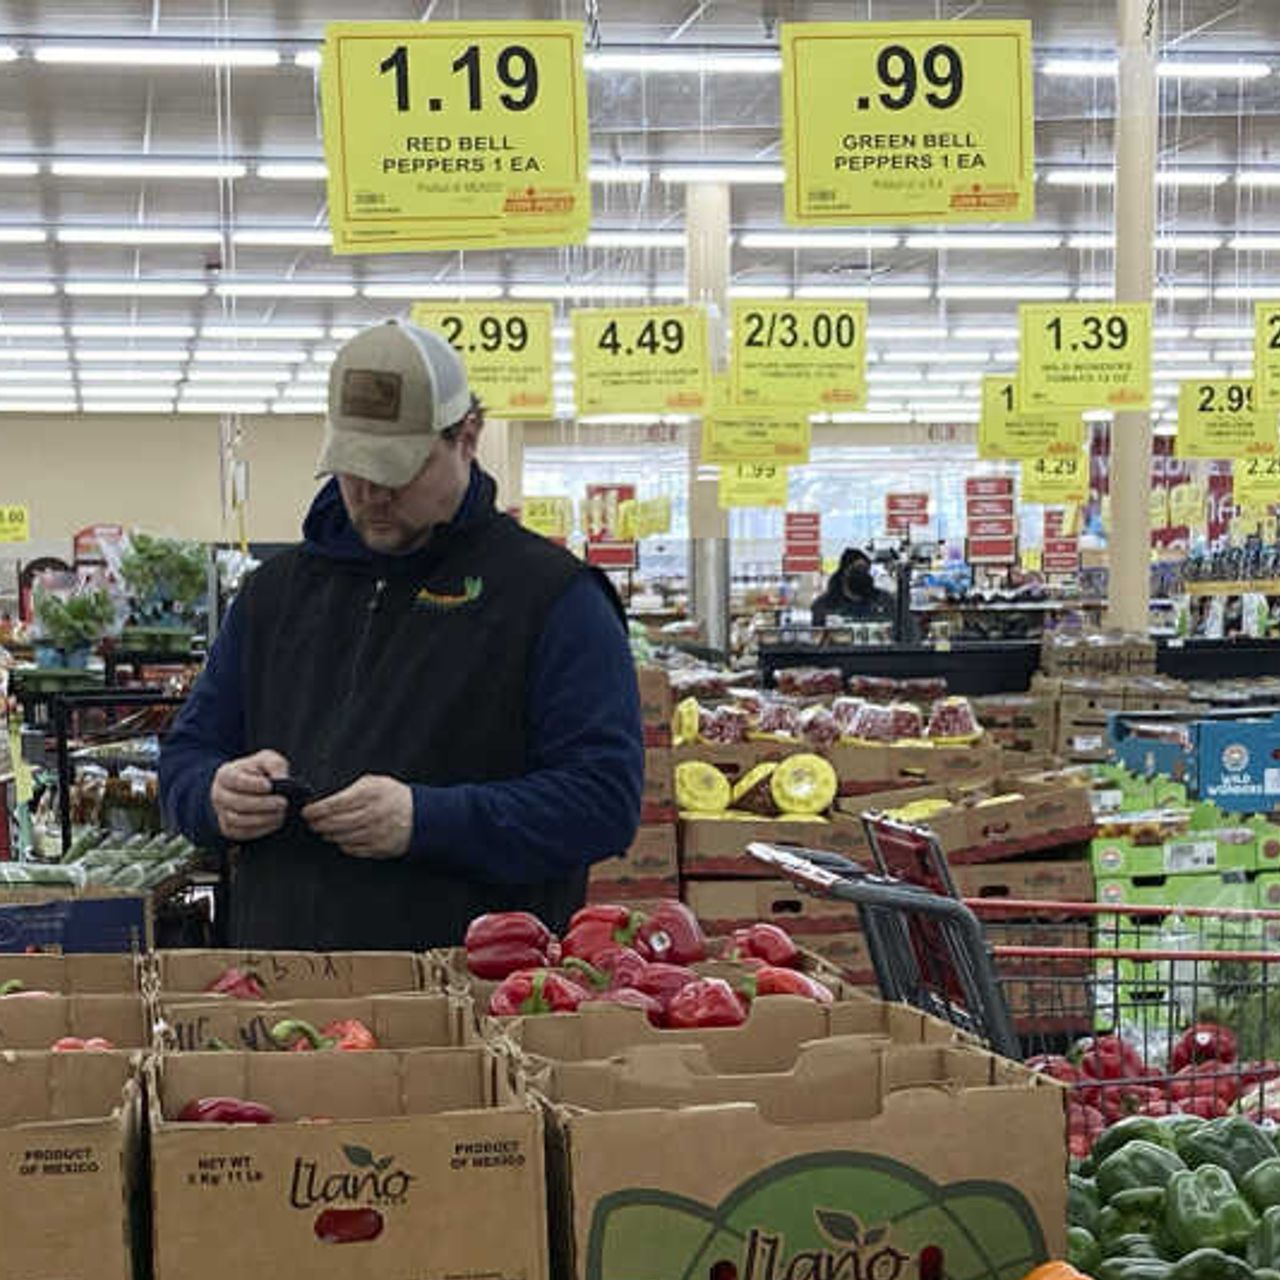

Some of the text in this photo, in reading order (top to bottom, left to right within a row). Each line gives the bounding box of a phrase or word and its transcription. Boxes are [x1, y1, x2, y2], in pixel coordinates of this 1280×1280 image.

[379, 45, 539, 112] 1.19
[856, 44, 964, 111] .99
[406, 135, 514, 152] RED BELL
[842, 133, 978, 151] GREEN BELL
[382, 156, 541, 174] PEPPERS 1 EA
[834, 153, 986, 171] PEPPERS 1 EA
[440, 316, 528, 351] 2.99
[598, 319, 685, 355] 4.49
[745, 313, 855, 348] 2/3.00
[1045, 316, 1128, 351] 1.39
[1035, 458, 1077, 475] 4.29
[43, 1161, 100, 1174] MEXICO
